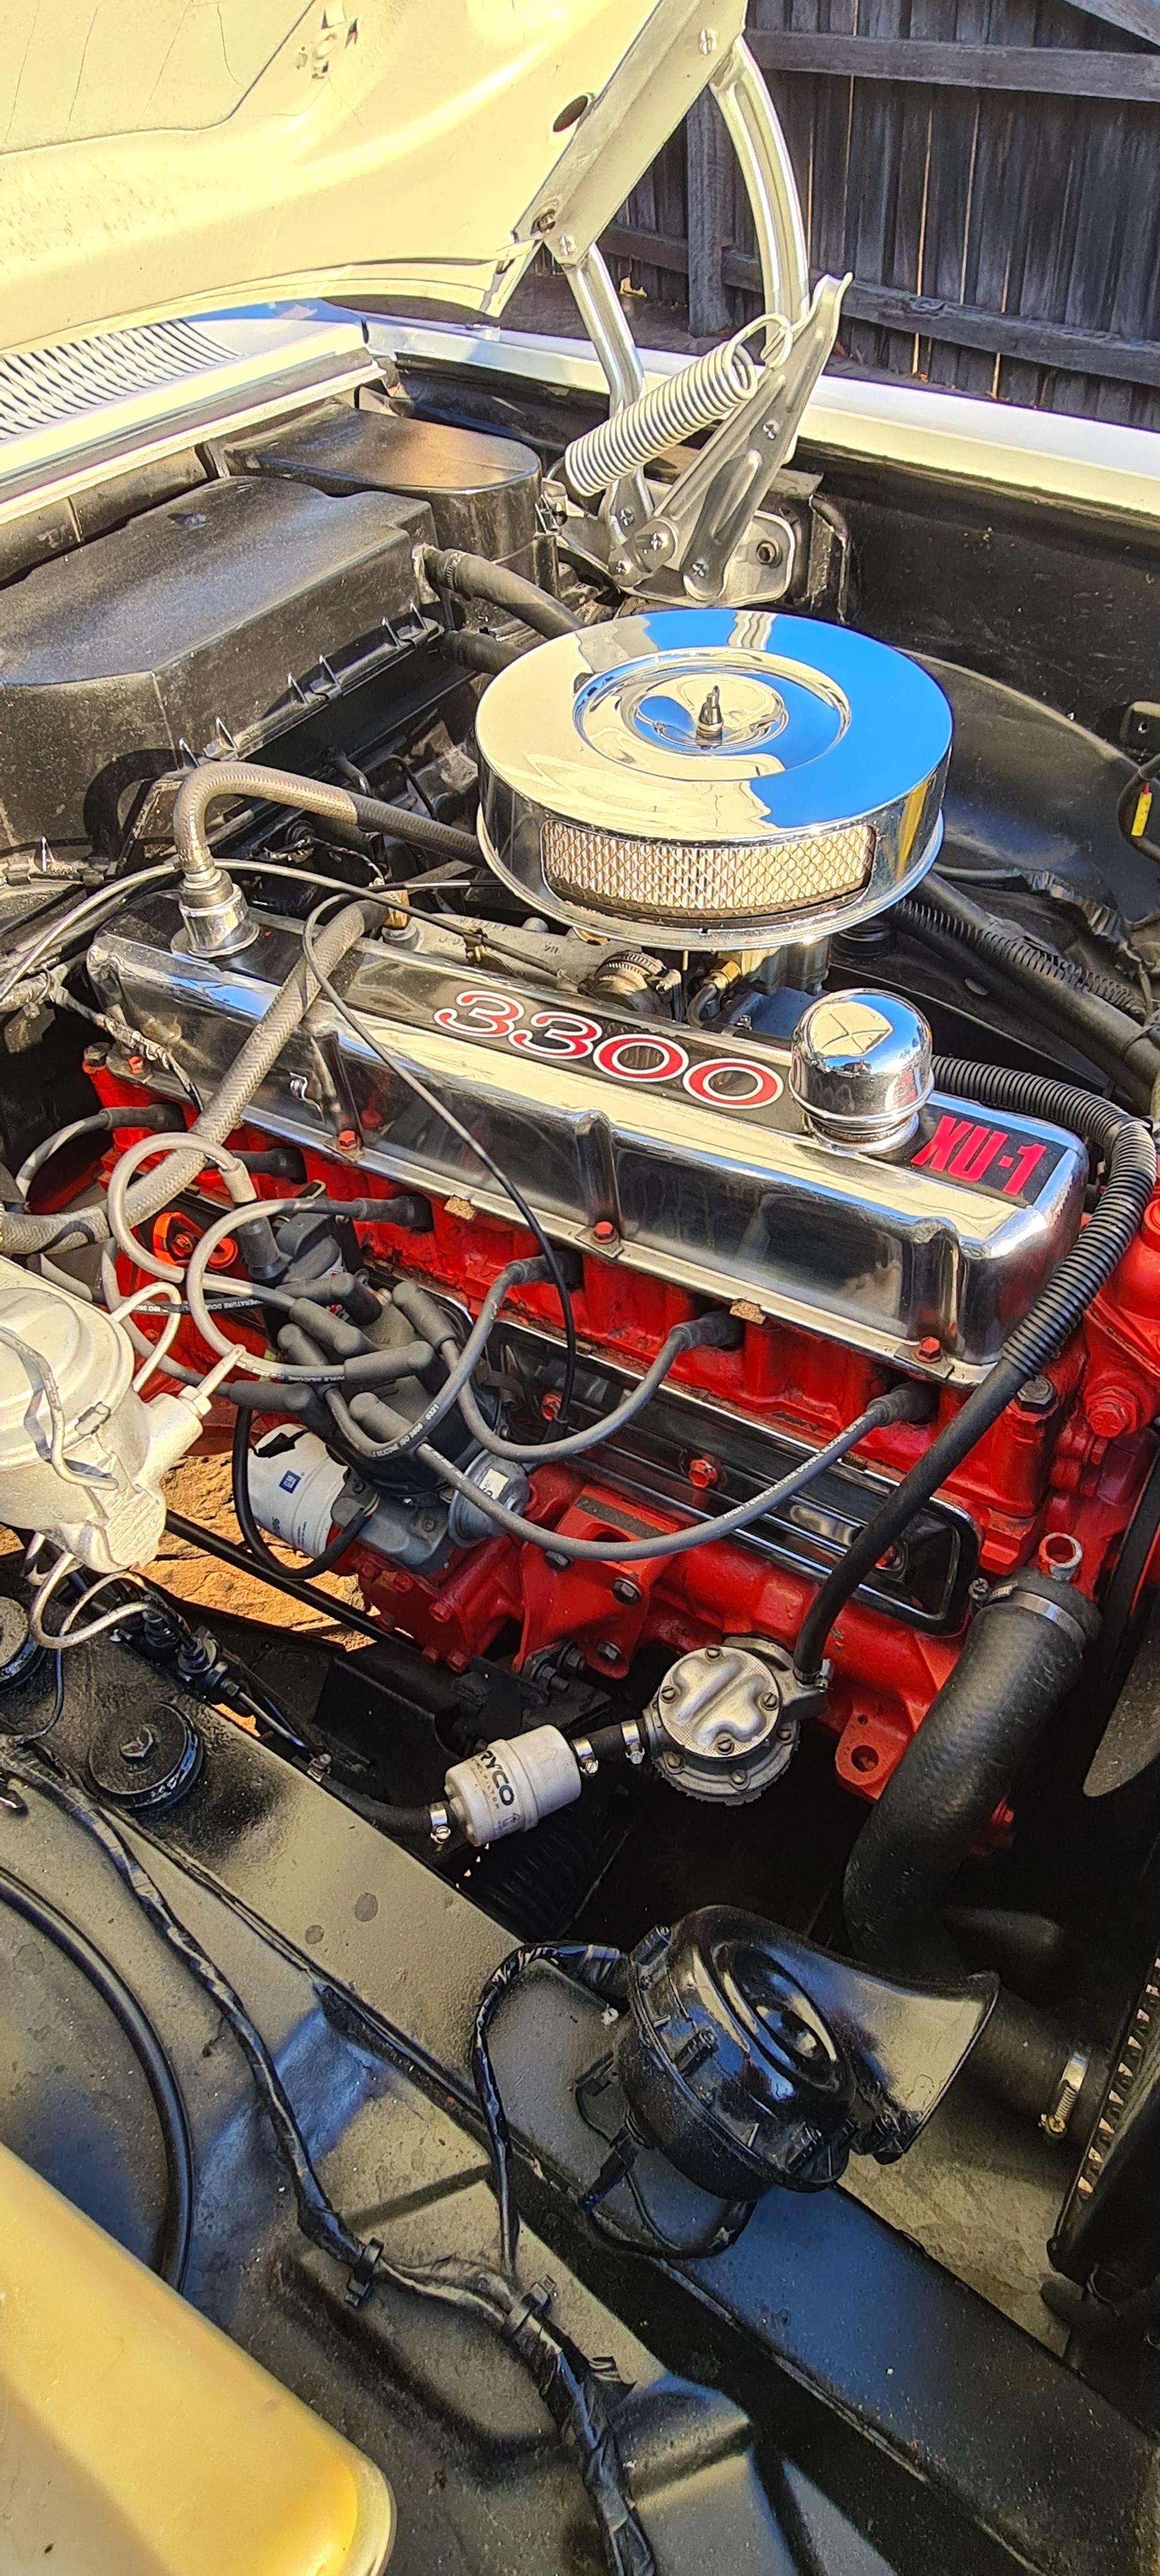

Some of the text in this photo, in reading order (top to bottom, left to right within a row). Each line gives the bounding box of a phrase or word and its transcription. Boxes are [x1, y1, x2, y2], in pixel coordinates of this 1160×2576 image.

[433, 990, 784, 1110] 3300
[910, 1115, 1046, 1195] XU-1
[724, 1505, 745, 1520] HIGH
[745, 1471, 798, 1507] TEMPERATURE
[798, 1452, 824, 1473] DOUBLE
